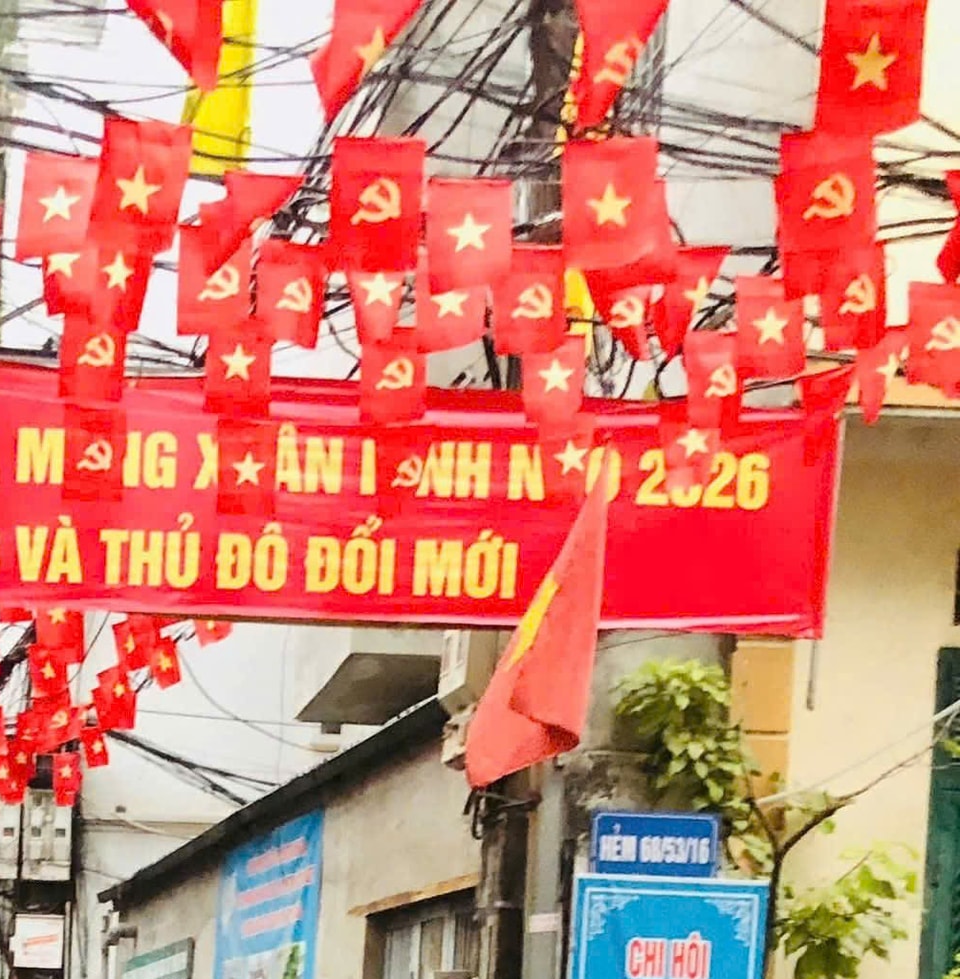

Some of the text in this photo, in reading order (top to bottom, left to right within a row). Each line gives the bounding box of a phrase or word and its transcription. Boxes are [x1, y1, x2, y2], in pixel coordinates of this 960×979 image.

[193, 422, 344, 494] XÂN
[635, 448, 772, 511] 226
[15, 515, 83, 584] VÀ
[100, 513, 201, 588] THỦ
[215, 522, 289, 591] ĐÔ
[304, 515, 397, 596] ĐỔI
[411, 529, 519, 600] MỚI
